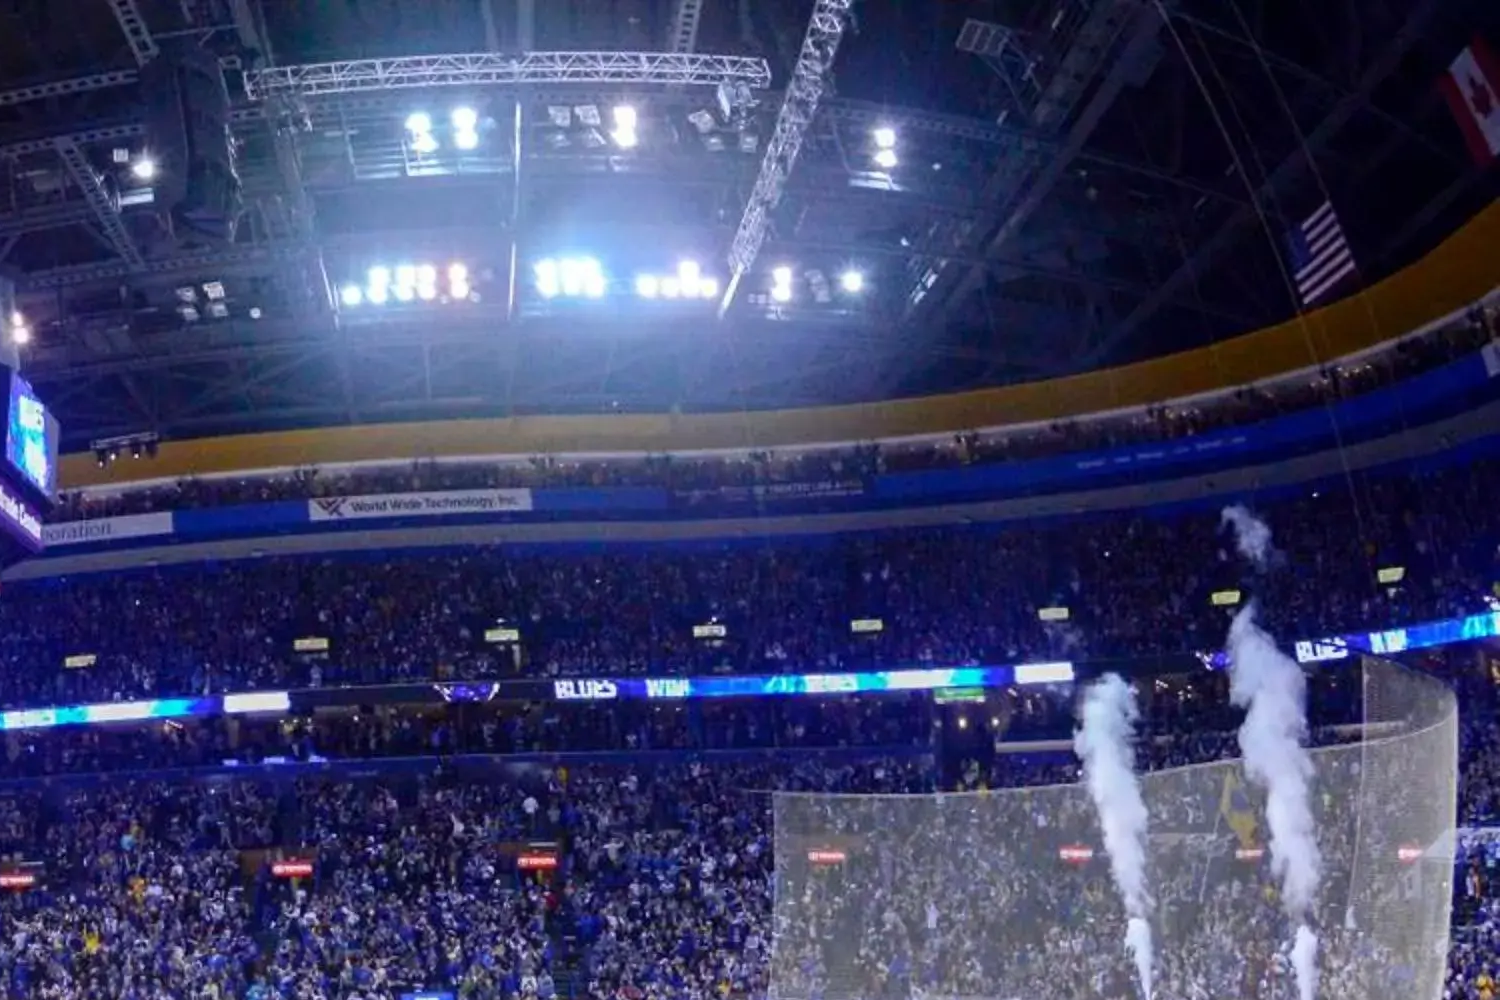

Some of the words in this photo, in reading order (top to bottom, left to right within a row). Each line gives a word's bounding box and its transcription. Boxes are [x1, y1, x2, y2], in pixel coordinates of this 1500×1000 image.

[350, 500, 388, 514] World
[390, 498, 422, 511] Wide
[554, 679, 618, 699] BLUES
